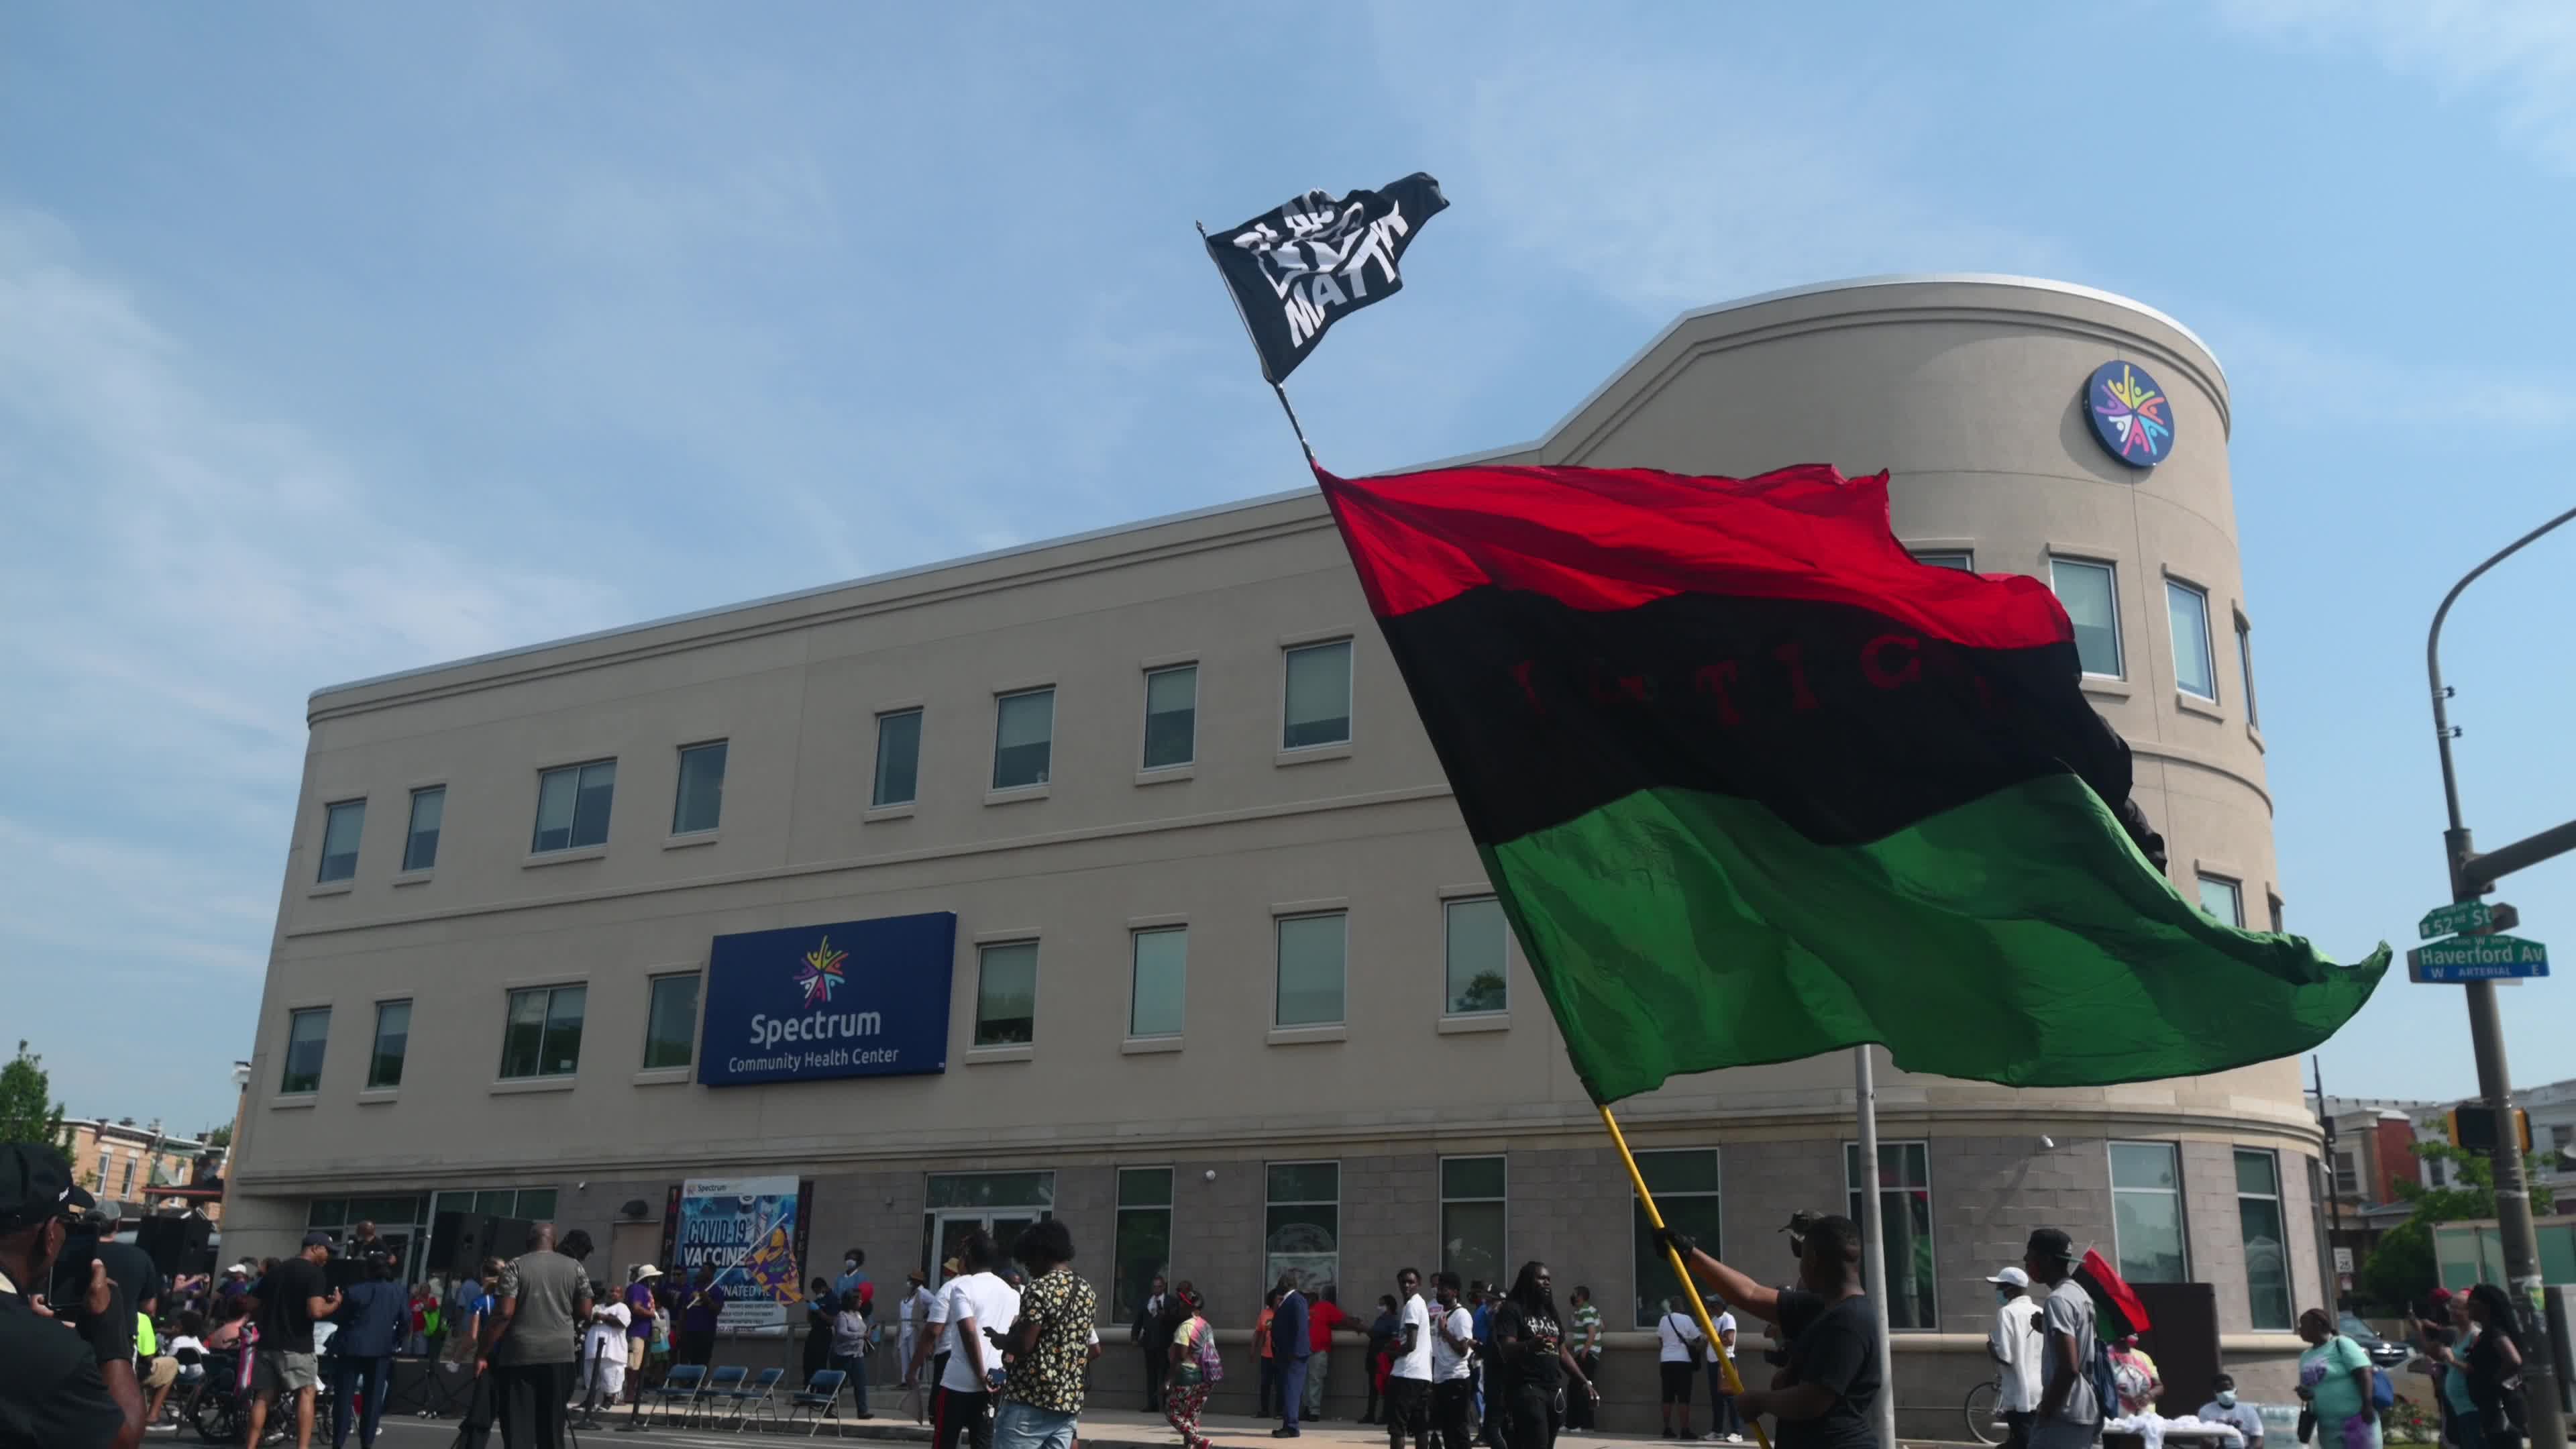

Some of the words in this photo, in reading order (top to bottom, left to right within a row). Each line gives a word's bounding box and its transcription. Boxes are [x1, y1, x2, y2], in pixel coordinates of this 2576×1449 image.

[2434, 914, 2466, 935] 52nd
[2473, 908, 2491, 926] St
[2476, 936, 2485, 945] W
[2420, 945, 2513, 965] Haverford
[2522, 946, 2543, 963] Av
[2430, 967, 2445, 978] W
[2458, 966, 2512, 977] ARTERIAL
[2531, 964, 2540, 976] E
[749, 1010, 881, 1050] Spectrum
[729, 1052, 802, 1073] Community
[805, 1049, 849, 1067] Health
[853, 1047, 900, 1065] Center
[698, 1185, 727, 1193] Spectrum
[688, 1219, 747, 1244] COVID-19
[684, 1246, 748, 1267] VACCINE
